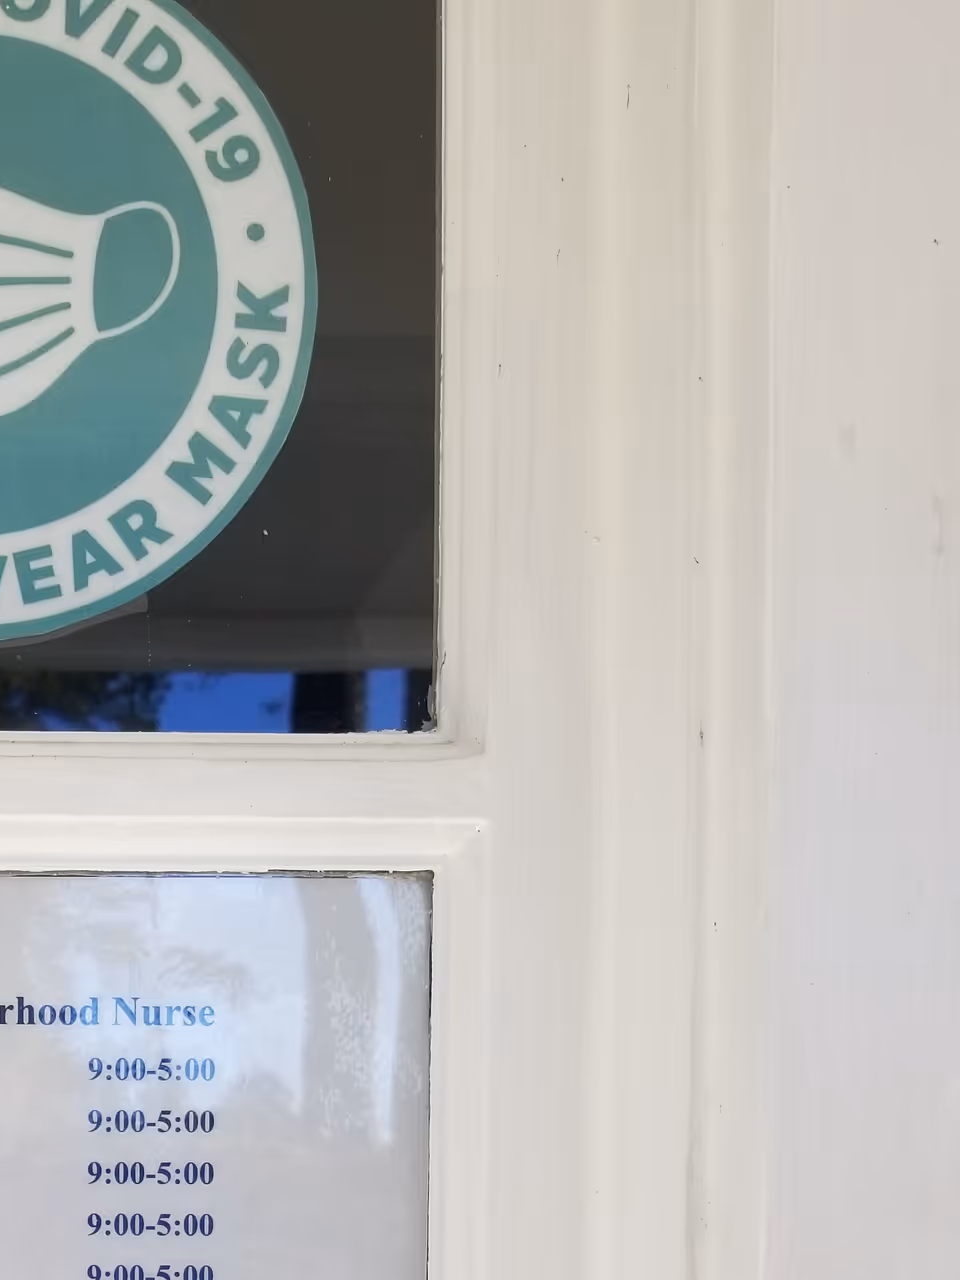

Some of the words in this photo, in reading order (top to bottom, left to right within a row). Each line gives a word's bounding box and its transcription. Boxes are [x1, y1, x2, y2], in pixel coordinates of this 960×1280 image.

[165, 280, 290, 506] MASK
[111, 996, 215, 1027] Nurse
[87, 1057, 215, 1081] 9:00-5:00
[87, 1109, 214, 1133] 9:00-5:00
[87, 1161, 214, 1185] 9:00-5:00
[86, 1212, 214, 1236] 9:00-5:00
